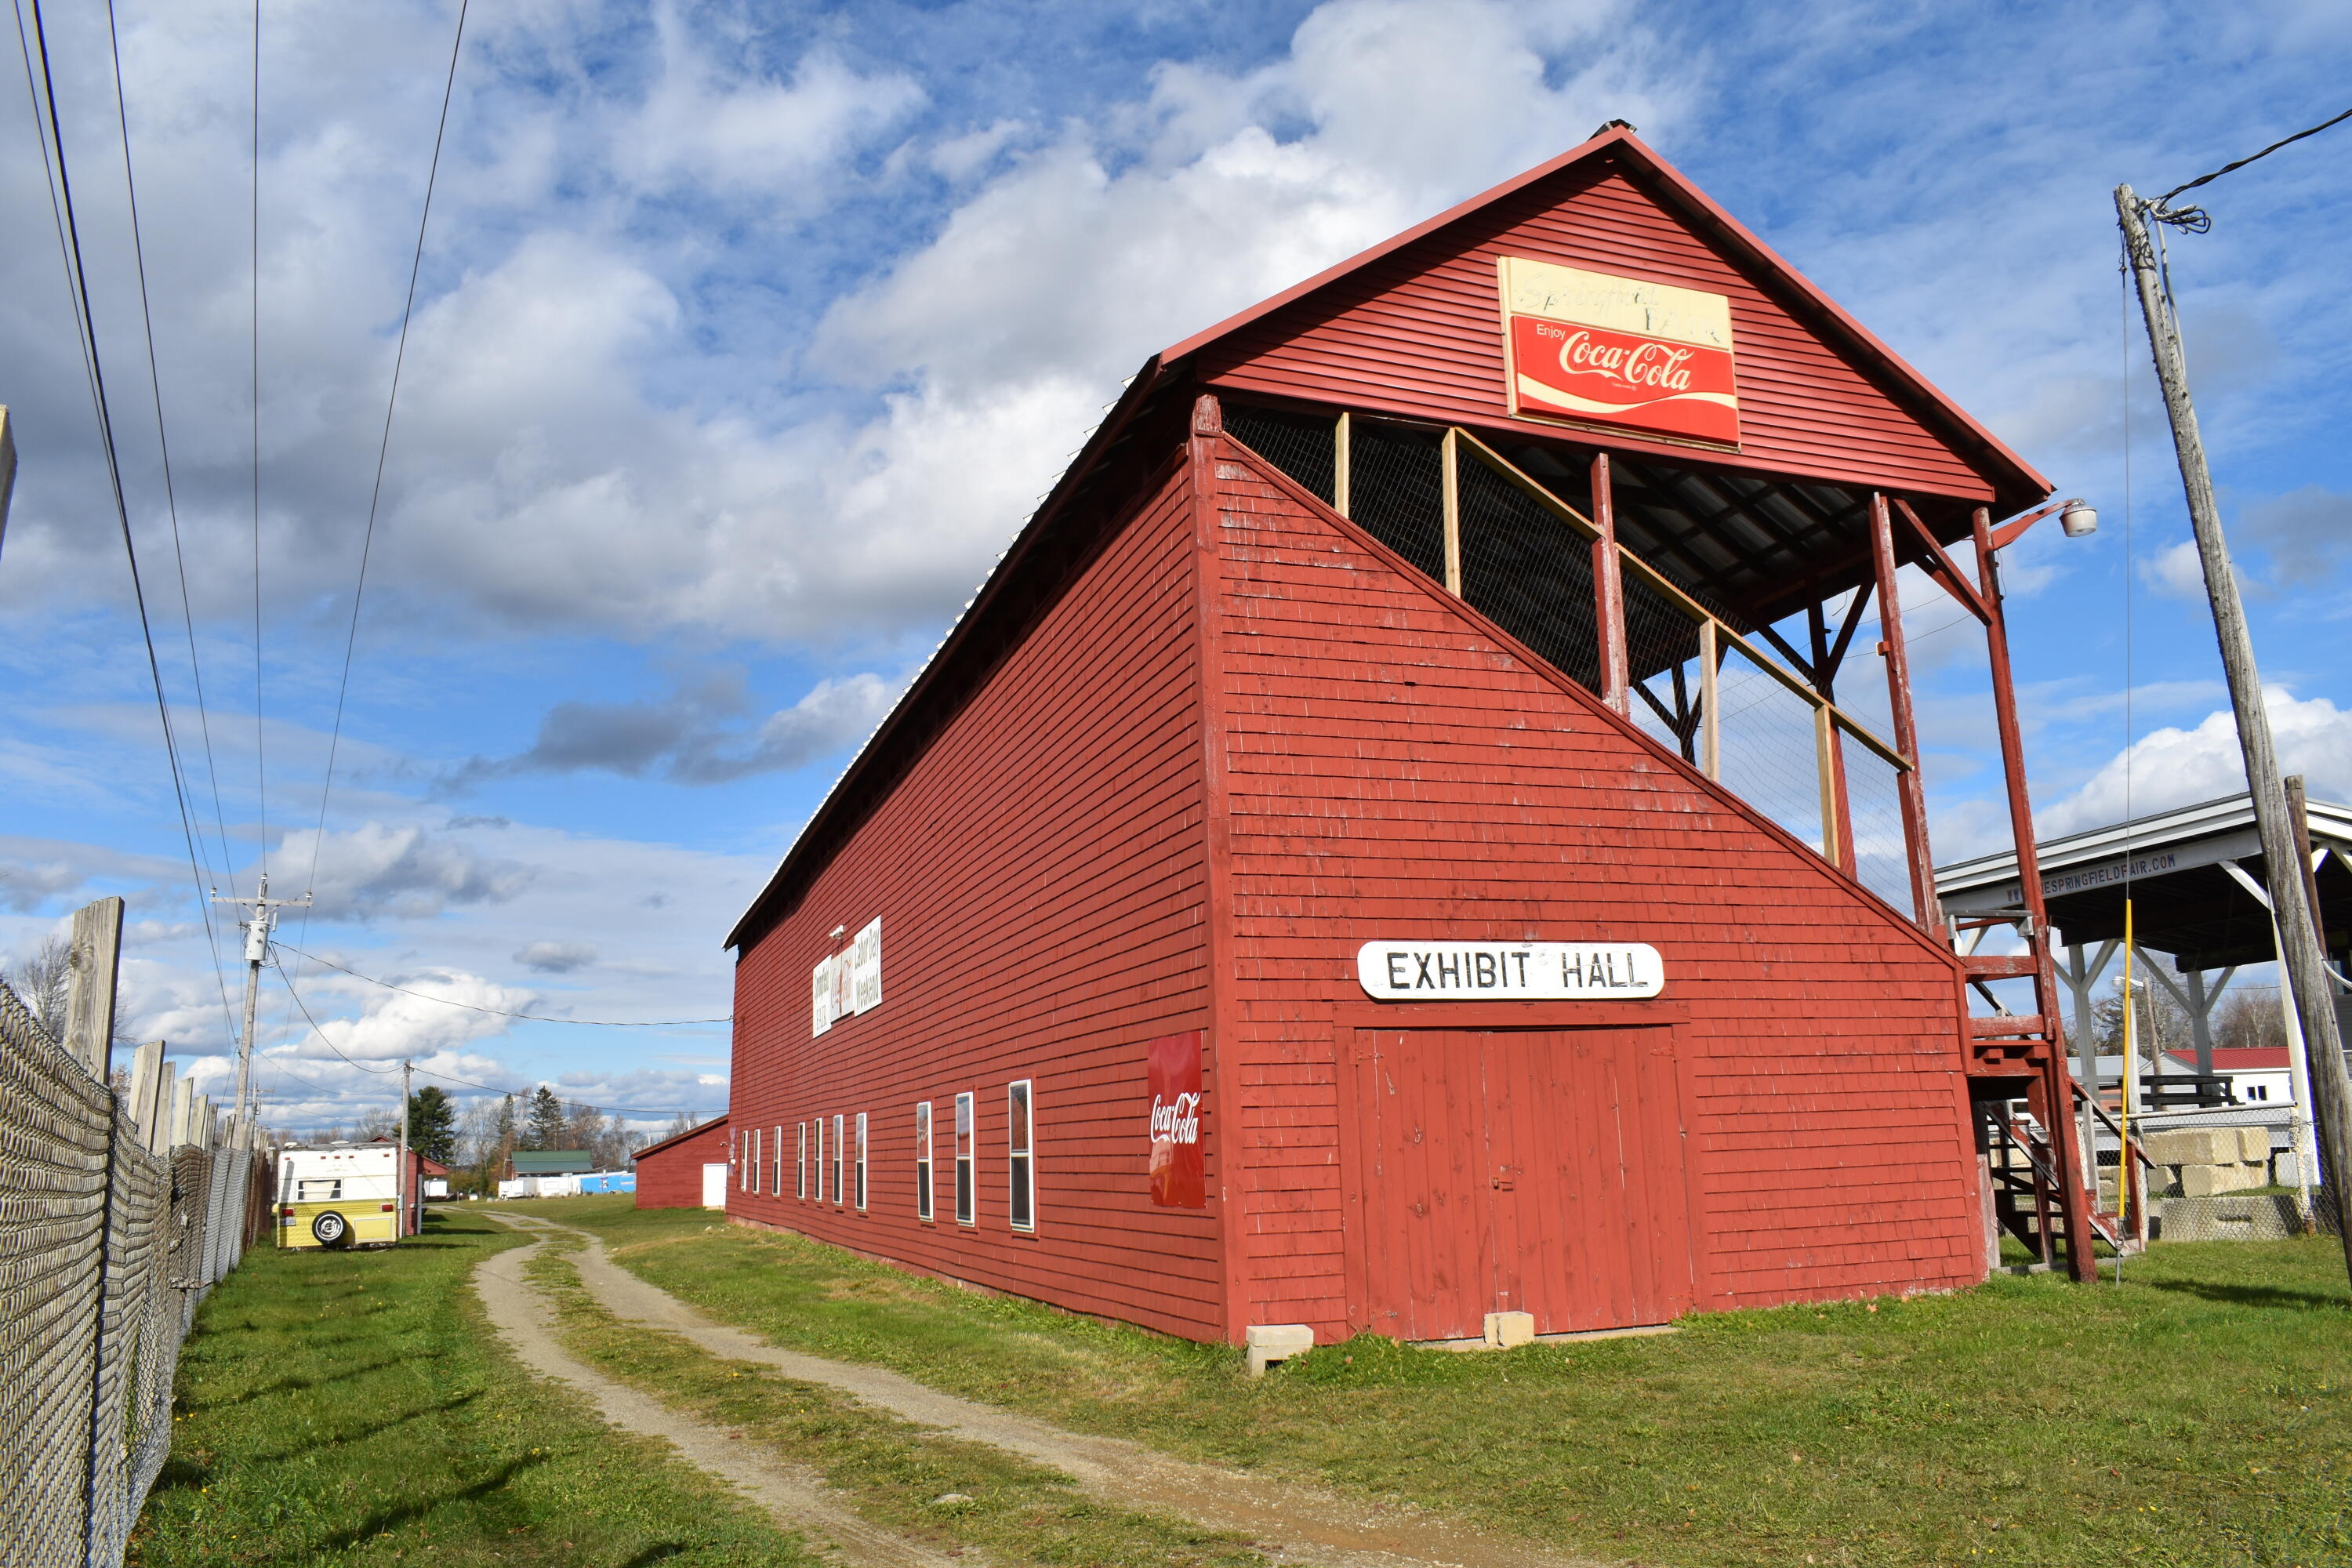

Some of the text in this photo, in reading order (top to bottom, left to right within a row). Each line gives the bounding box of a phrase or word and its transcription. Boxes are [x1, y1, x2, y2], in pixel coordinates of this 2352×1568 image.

[1537, 324, 1566, 340] Enjoy
[1559, 331, 1694, 390] Coca-Cola
[855, 928, 879, 970] Labor Day
[1387, 951, 1648, 989] EXHIBIT HALL
[856, 967, 879, 1010] Weekend
[1150, 1092, 1200, 1145] Coca-Cola
